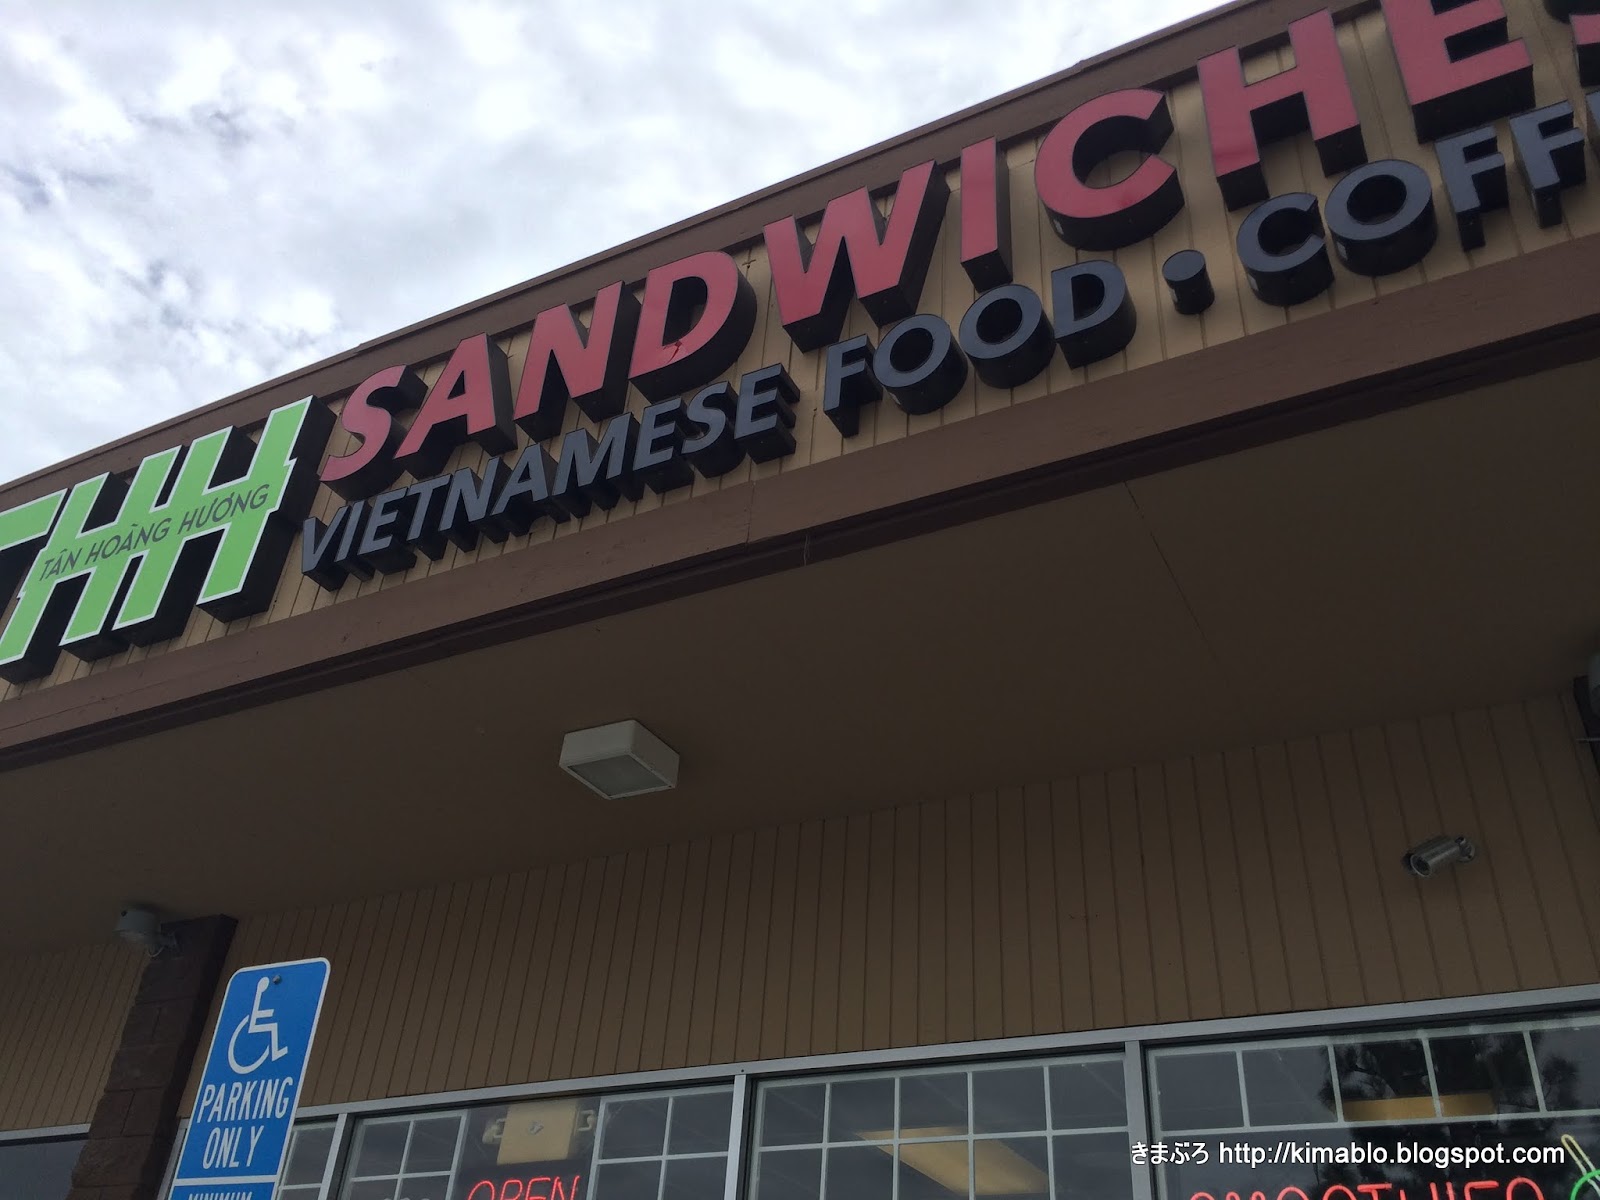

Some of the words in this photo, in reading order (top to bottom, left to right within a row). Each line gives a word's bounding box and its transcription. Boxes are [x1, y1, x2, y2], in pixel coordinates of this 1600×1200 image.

[302, 362, 784, 577] VIETNAMESE
[823, 259, 1126, 414] FOOD
[1236, 90, 1600, 273] COFF
[319, 0, 1600, 482] SANDWICHE
[196, 1076, 294, 1124] PARKING
[203, 1125, 265, 1170] ONLY
